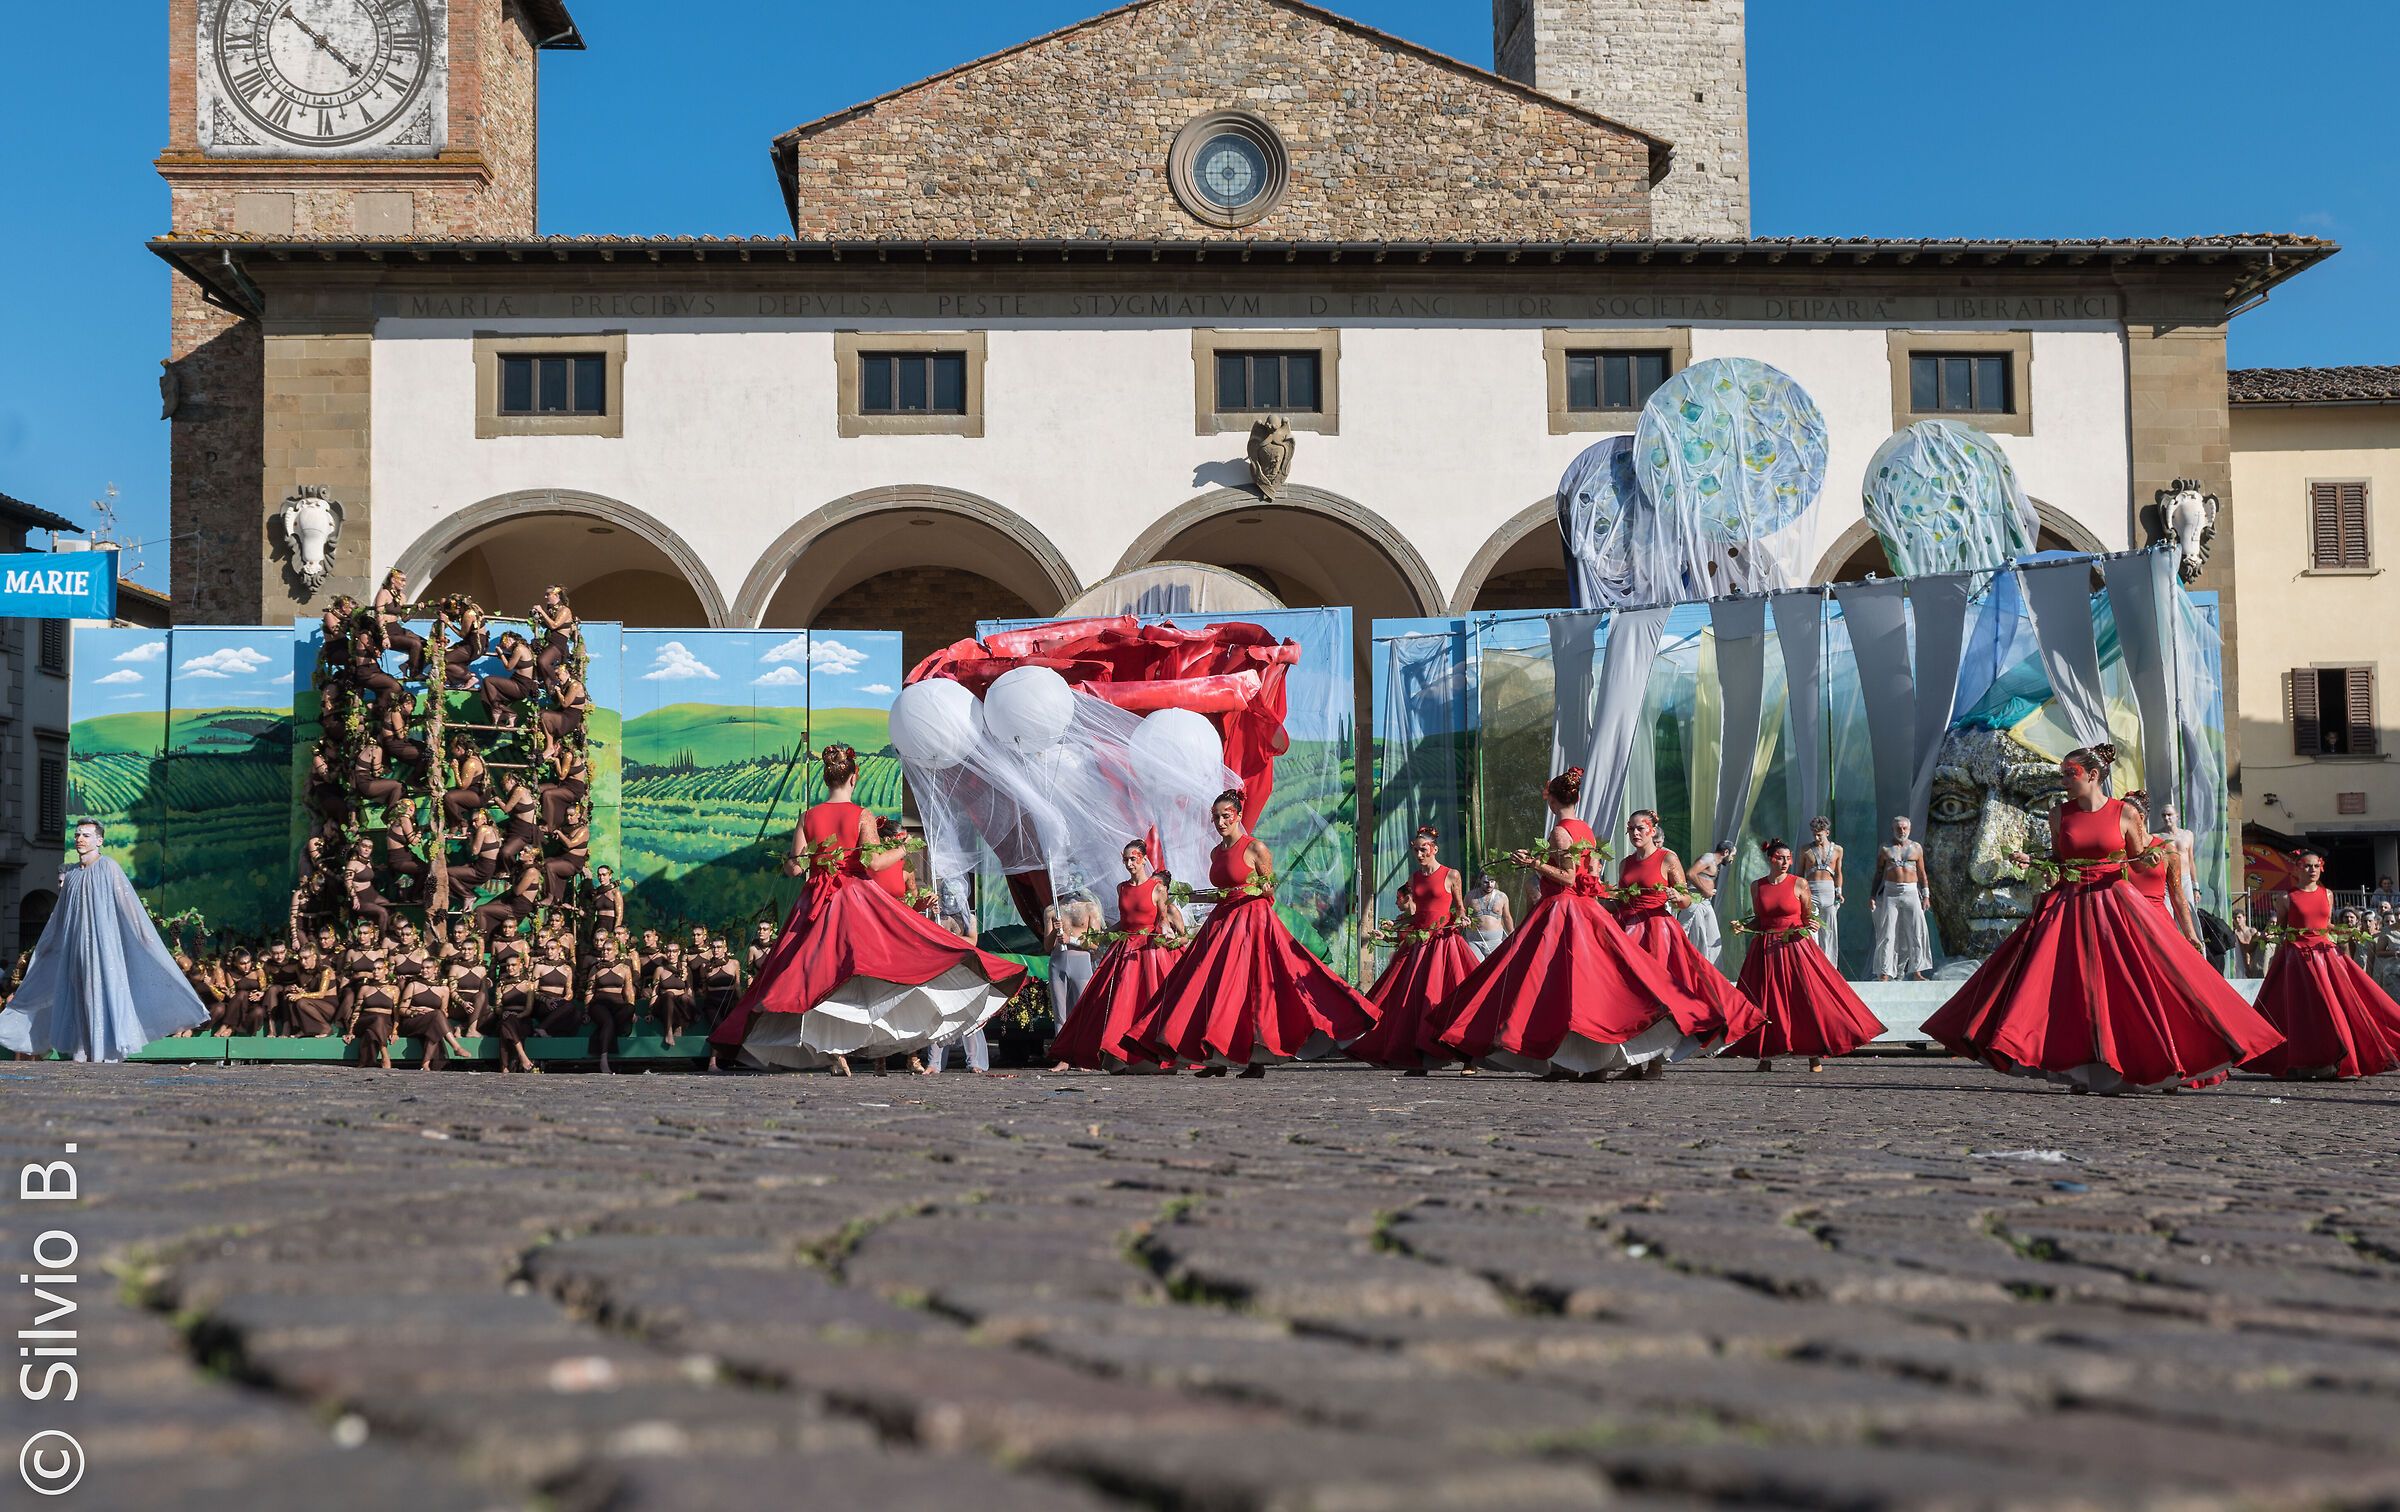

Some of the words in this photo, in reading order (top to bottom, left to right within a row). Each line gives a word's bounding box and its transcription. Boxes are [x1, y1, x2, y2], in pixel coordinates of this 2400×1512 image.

[758, 295, 893, 316] DEPVLSA
[939, 295, 1030, 316] PESTE
[1486, 296, 1553, 316] FLOR
[1593, 297, 1723, 318] SOCIETAS
[4, 570, 89, 595] MARIE
